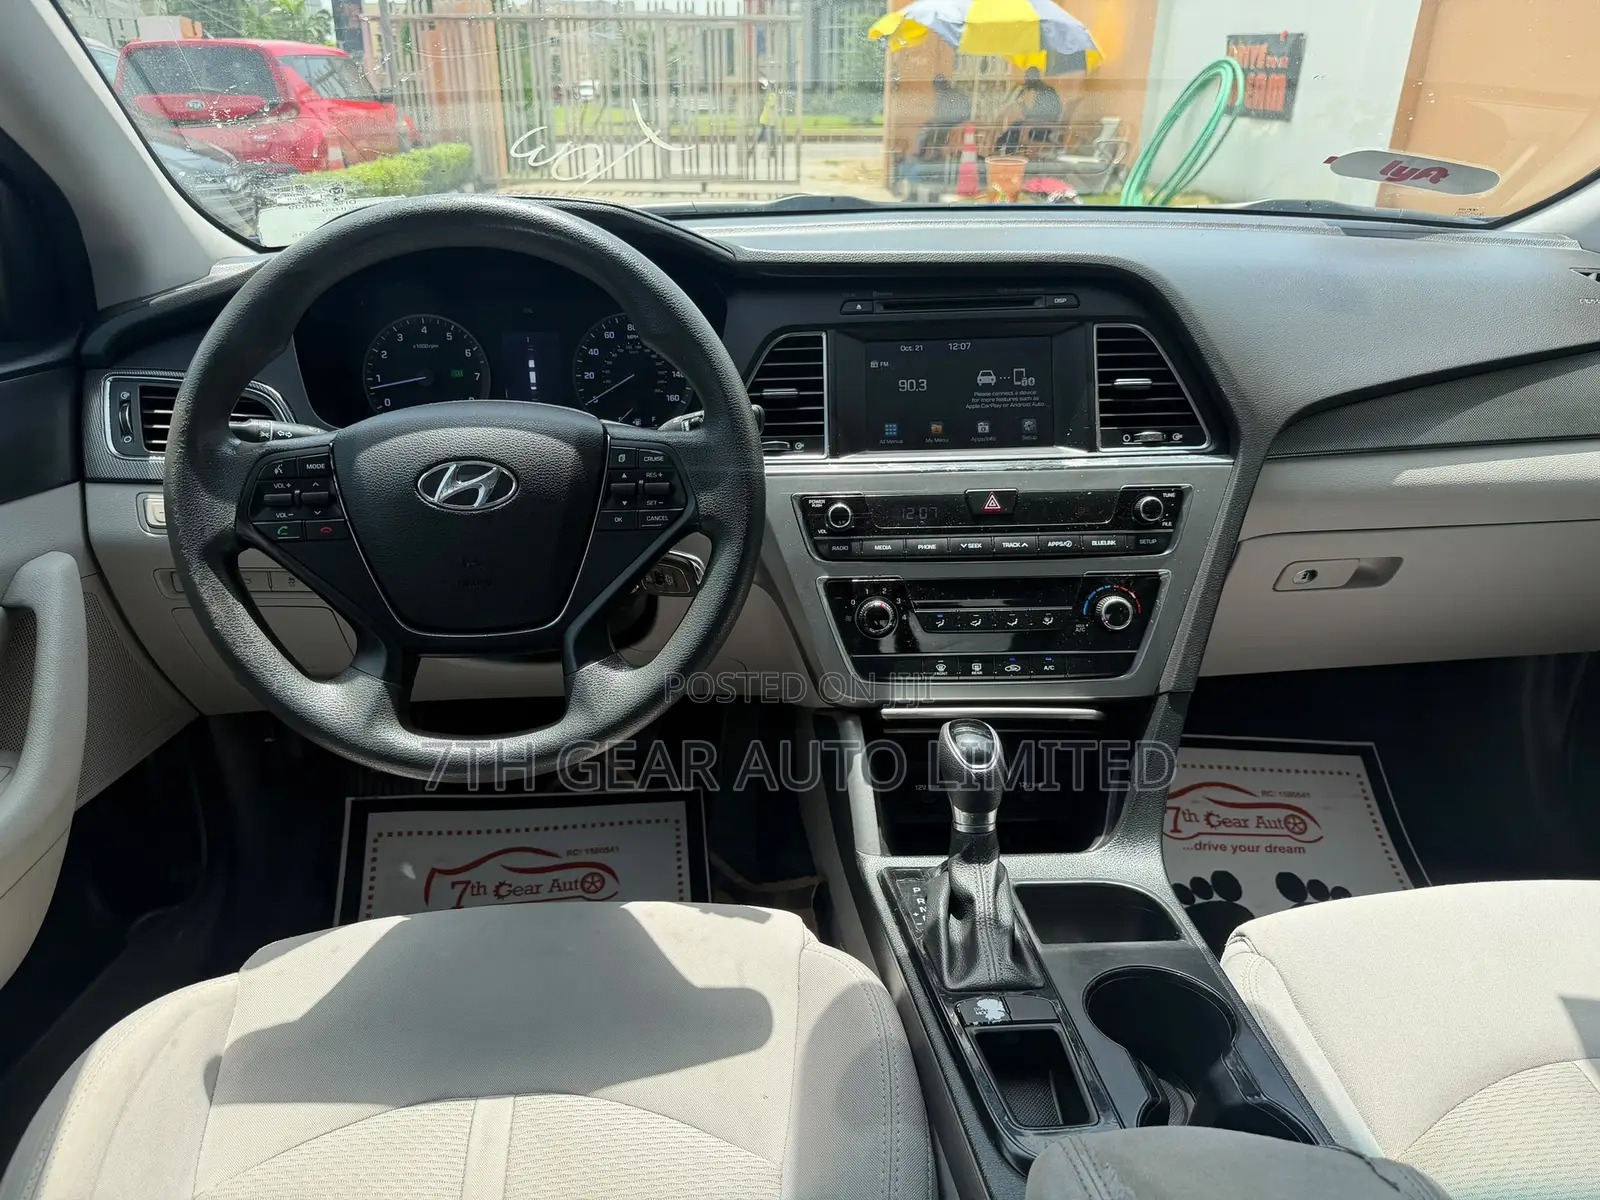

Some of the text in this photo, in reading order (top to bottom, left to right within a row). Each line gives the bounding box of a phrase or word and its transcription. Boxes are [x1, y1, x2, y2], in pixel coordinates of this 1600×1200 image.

[1379, 159, 1450, 185] lyft
[421, 326, 428, 334] 4
[397, 333, 404, 342] 3
[446, 332, 453, 341] 5
[604, 331, 615, 339] 60
[948, 342, 971, 351] 12:07
[381, 350, 388, 359] 2
[465, 349, 472, 357] 6
[588, 348, 599, 356] 40
[376, 374, 381, 382] 1
[474, 372, 481, 381] 7
[584, 371, 595, 380] 20
[898, 379, 928, 392] 90.3
[384, 398, 391, 407] 0
[666, 394, 680, 402] 160
[1166, 806, 1199, 834] 7th
[1203, 810, 1250, 830] Gear
[1231, 843, 1260, 855] your
[1264, 843, 1306, 855] dream
[450, 880, 488, 909] 7th
[493, 880, 544, 900] Gear
[916, 897, 926, 905] R
